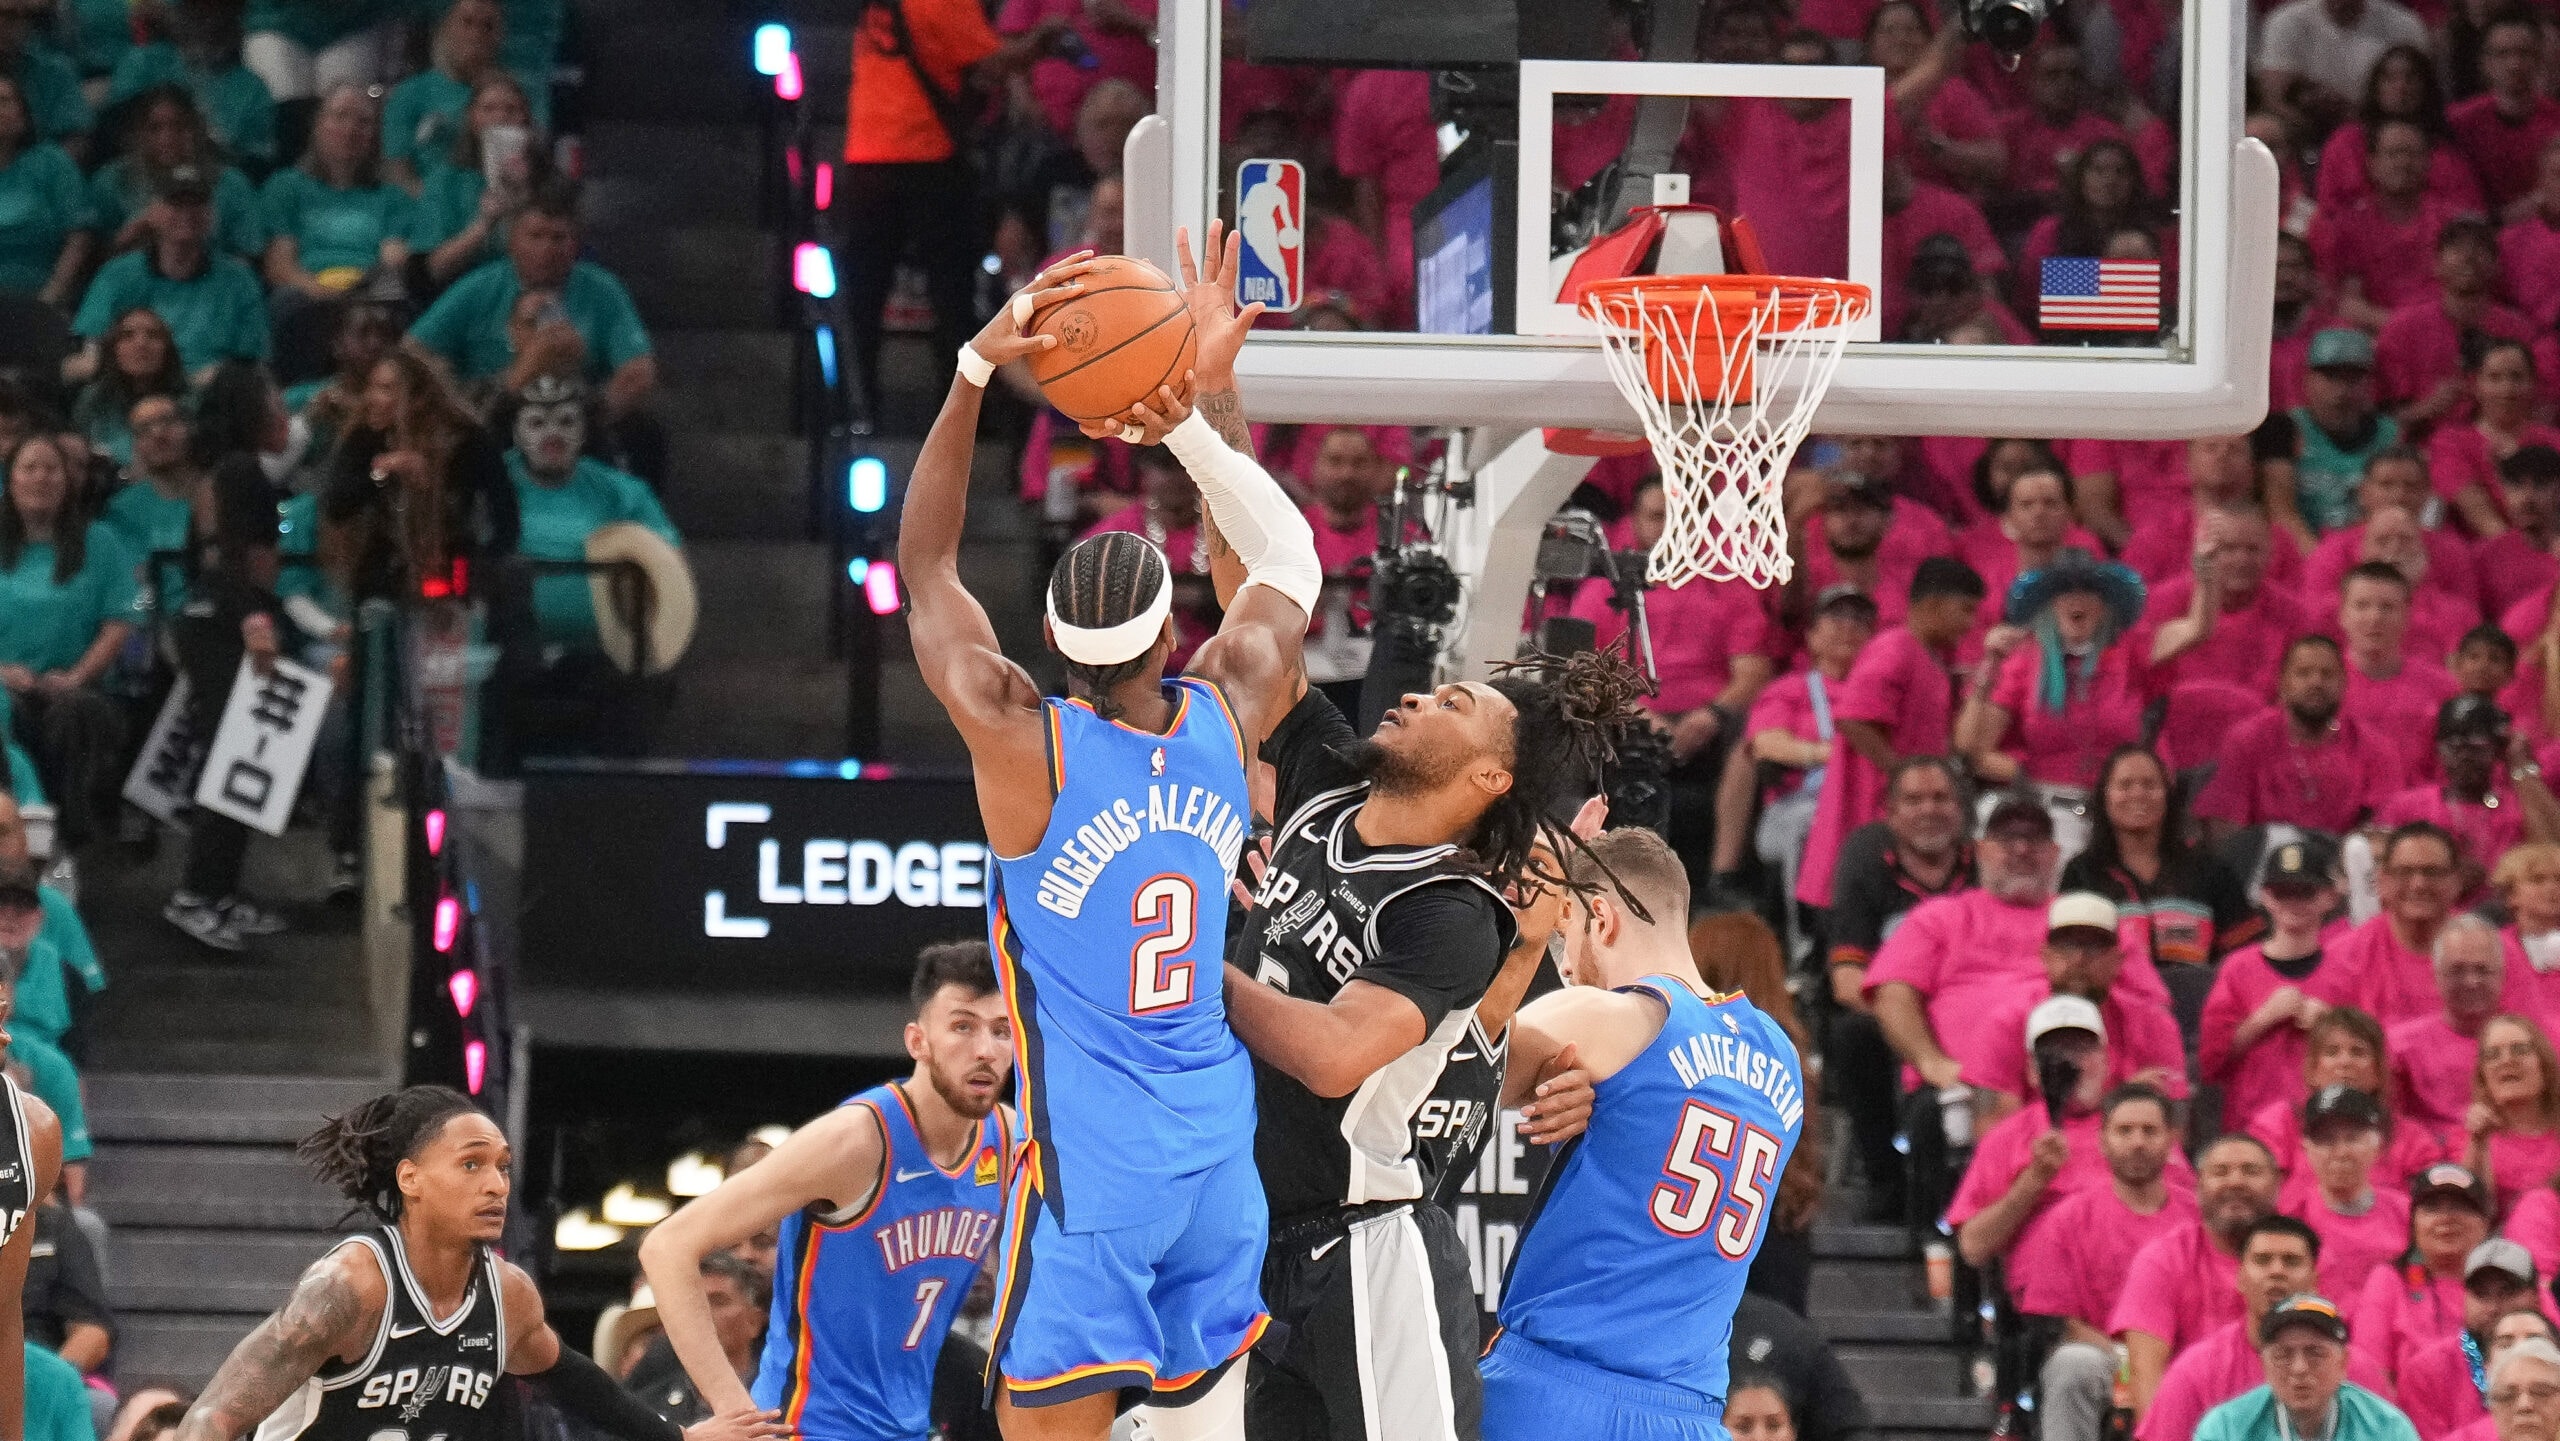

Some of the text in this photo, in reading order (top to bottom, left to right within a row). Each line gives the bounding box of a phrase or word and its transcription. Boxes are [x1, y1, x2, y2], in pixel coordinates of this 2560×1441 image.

[1245, 276, 1277, 301] NBA
[1036, 784, 1243, 919] GILGEOUS-ALEXAND
[1254, 866, 1363, 985] SPURS
[1338, 885, 1367, 914] LEDGER
[1129, 871, 1199, 1017] 2
[1648, 1098, 1783, 1261] 55
[462, 1337, 489, 1348] LEDGER
[902, 1277, 948, 1350] 7
[356, 1366, 493, 1420] SPURS
